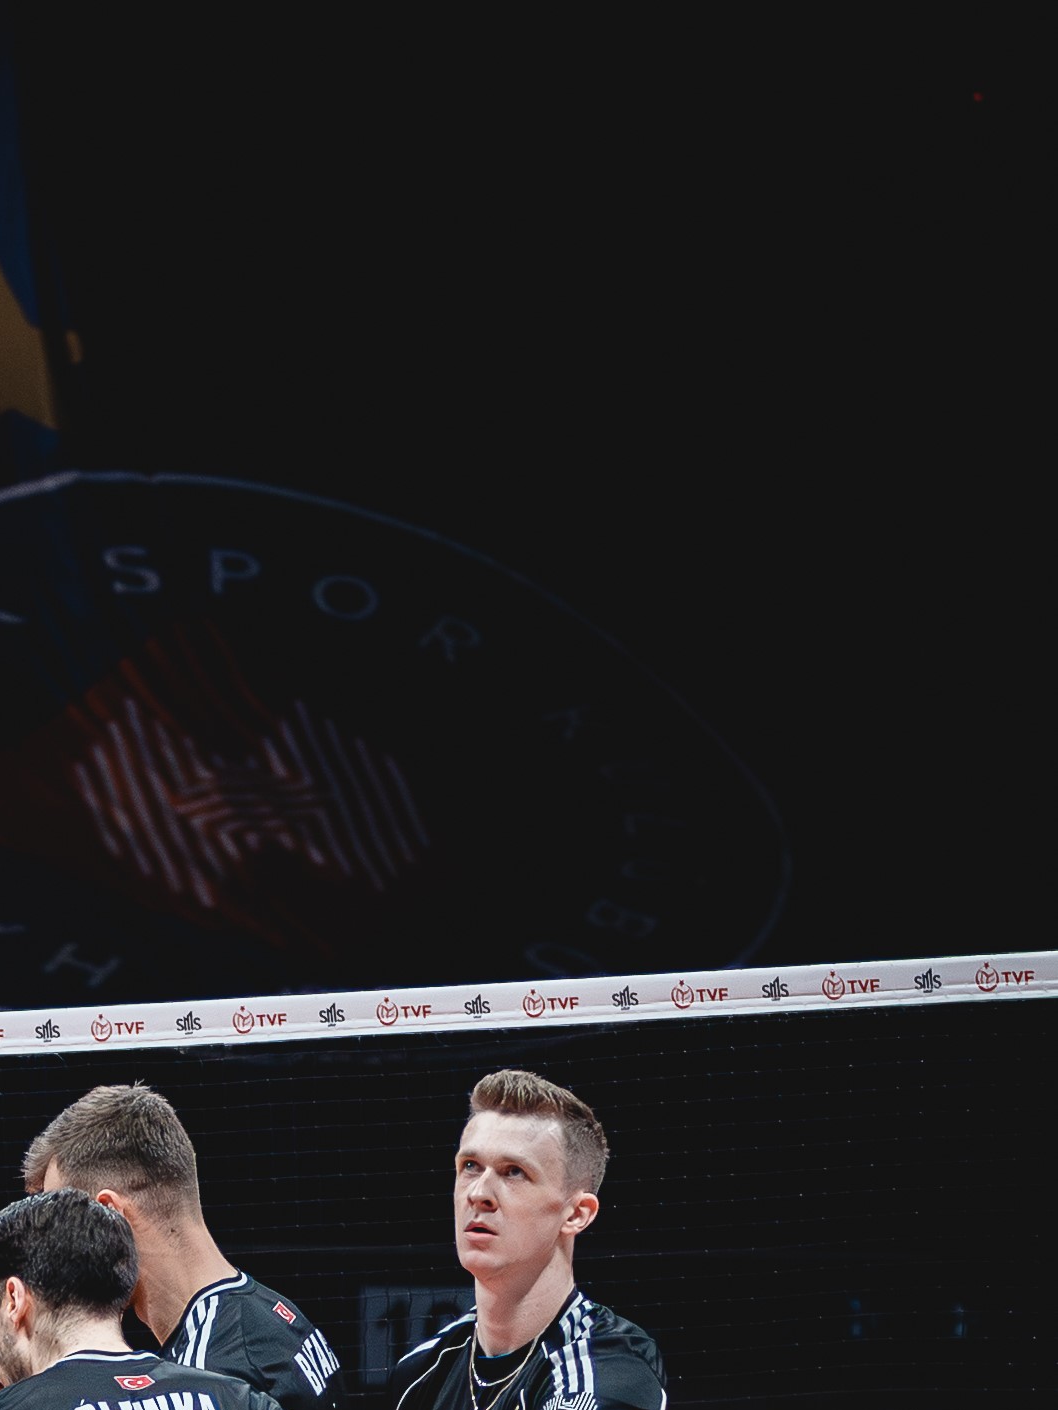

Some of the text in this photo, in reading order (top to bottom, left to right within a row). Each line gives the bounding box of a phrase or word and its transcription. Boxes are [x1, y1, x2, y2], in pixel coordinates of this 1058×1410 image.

[114, 1021, 145, 1035] TVF
[255, 1012, 288, 1026] TVF
[399, 1004, 432, 1018] TVF
[547, 996, 580, 1010] TVF
[695, 987, 729, 1001] TVF
[846, 979, 880, 993] TVF
[1001, 969, 1035, 983] TVF
